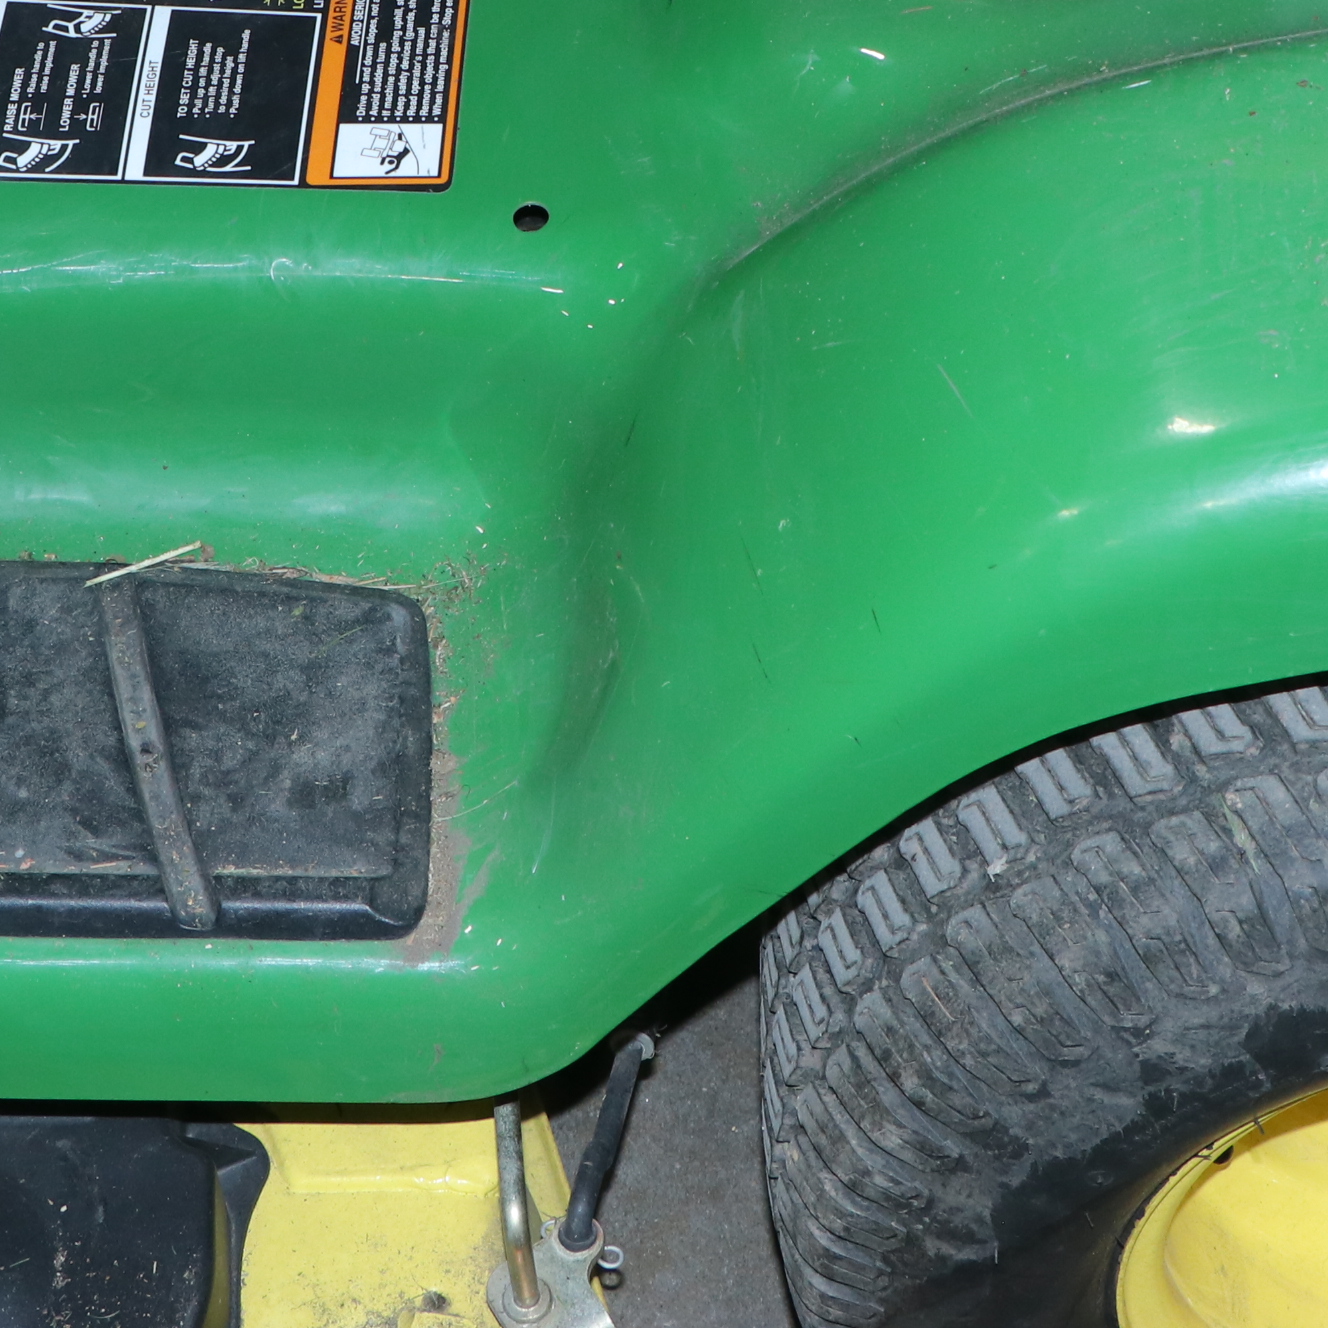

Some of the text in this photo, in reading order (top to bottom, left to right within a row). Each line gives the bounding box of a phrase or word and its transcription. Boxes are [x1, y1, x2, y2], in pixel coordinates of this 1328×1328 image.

[370, 4, 379, 16] not
[431, 14, 440, 23] be
[350, 22, 363, 46] AVOID
[367, 18, 378, 43] slopes,
[364, 45, 374, 65] down
[427, 39, 437, 54] that
[177, 39, 199, 118] TO SET CUT HEIGHT
[193, 43, 212, 113] Pull up on lift handle
[223, 56, 234, 77] height
[362, 67, 372, 82] and
[407, 28, 425, 116] Read operator's manual
[424, 56, 436, 83] objects
[140, 60, 159, 118] CUT HEIGHT
[205, 47, 224, 113] Turn lift adjust stop
[220, 79, 230, 104] desired
[361, 83, 371, 93] up
[370, 43, 387, 116] Avoid sudden turns
[4, 68, 25, 131] RAISE MOWER
[59, 64, 80, 131] LOWER MOWER
[356, 95, 367, 116] Drive
[420, 85, 432, 116] Remove
